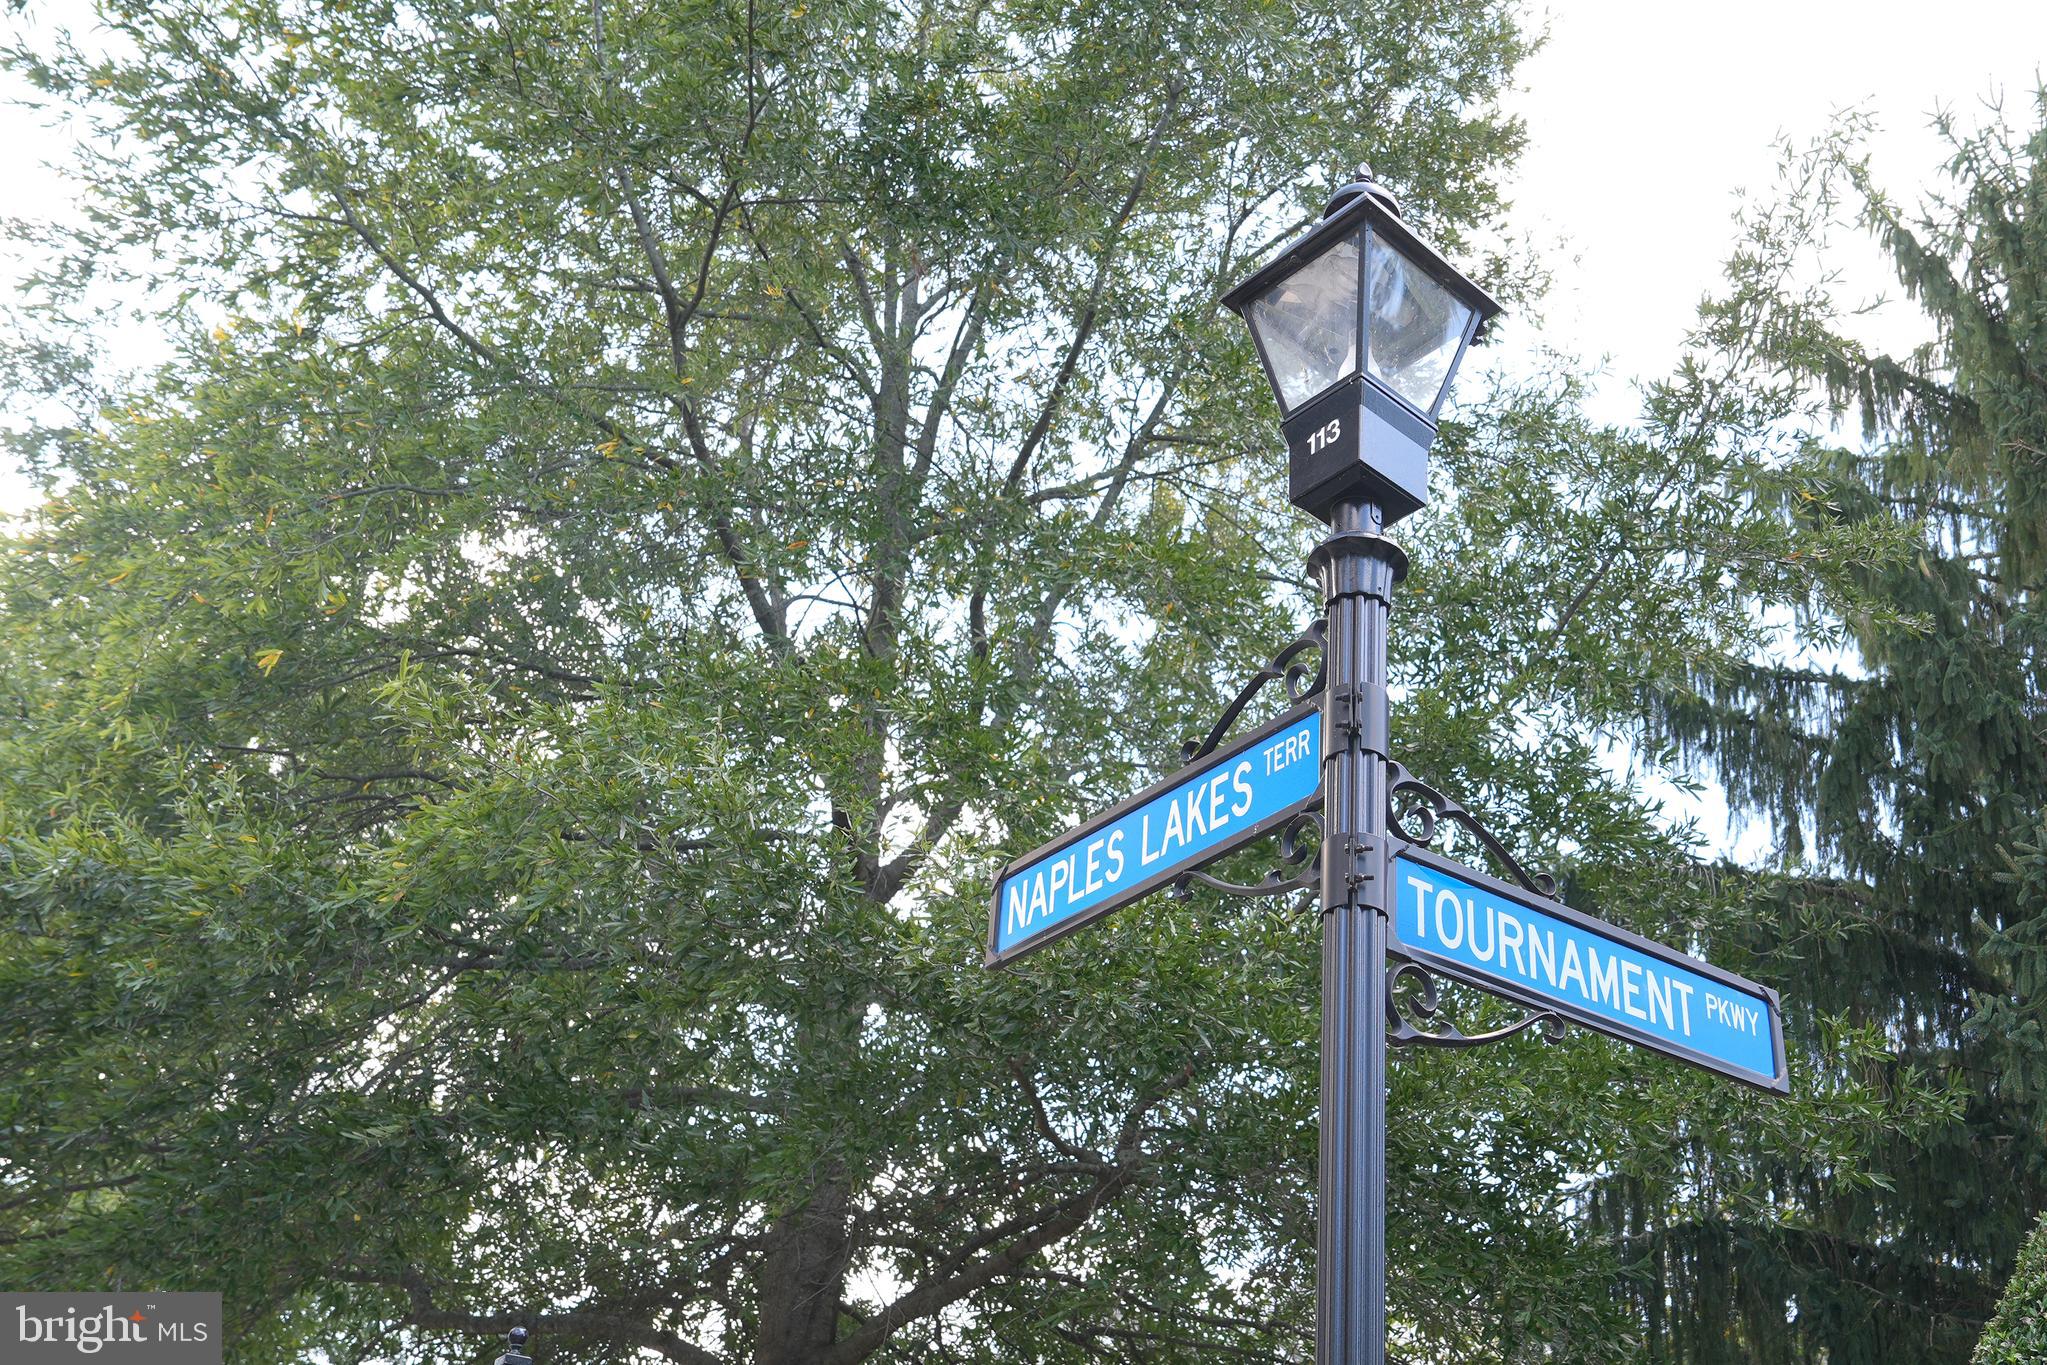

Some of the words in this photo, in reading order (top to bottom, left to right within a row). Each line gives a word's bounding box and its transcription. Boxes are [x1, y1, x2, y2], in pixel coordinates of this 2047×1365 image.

[1306, 418, 1341, 455] 113
[1007, 829, 1125, 935] NAPLES
[1141, 761, 1252, 866] LAKES
[1263, 729, 1311, 777] TERR
[1407, 876, 1694, 1037] TOURNAMENT
[1705, 992, 1759, 1037] PKWY
